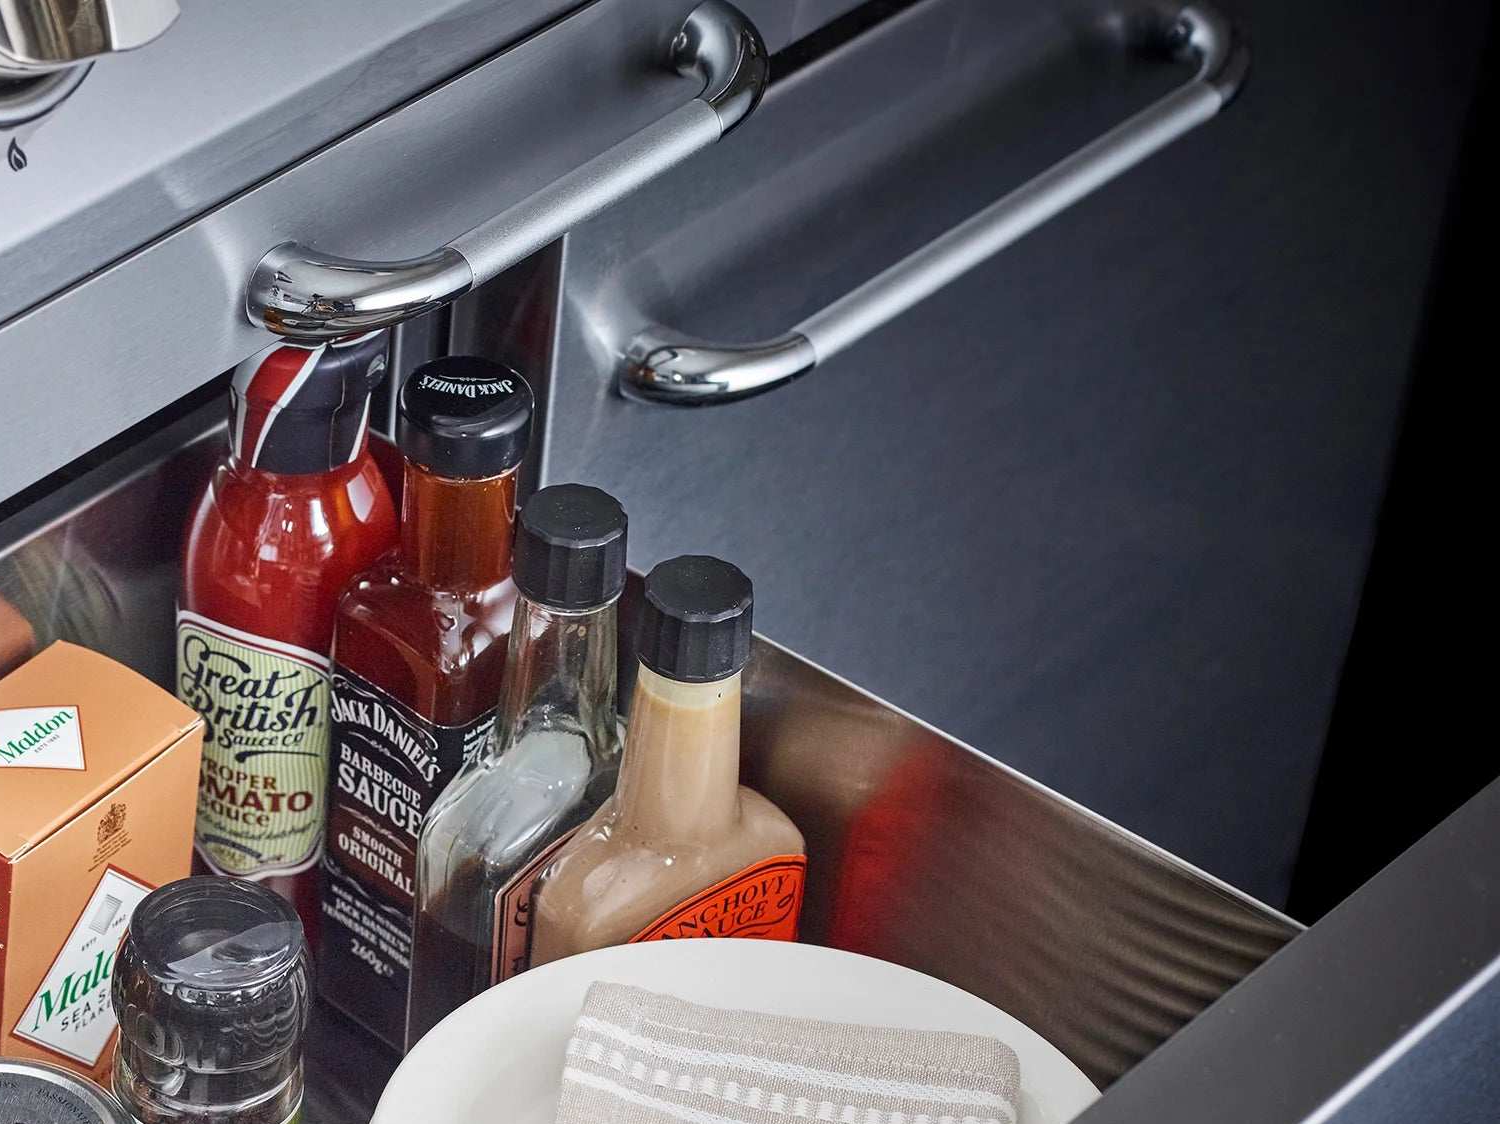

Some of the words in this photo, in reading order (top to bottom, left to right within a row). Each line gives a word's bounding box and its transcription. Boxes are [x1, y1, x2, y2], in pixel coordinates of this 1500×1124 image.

[477, 379, 514, 395] JACK
[184, 634, 301, 700] Great
[218, 728, 278, 749] Sauce
[331, 690, 372, 728] JACK
[373, 702, 441, 782] DANIEL'S
[338, 763, 422, 839] SAUCE
[340, 743, 421, 809] BARBECUE
[338, 833, 415, 897] ORIGINAL
[352, 826, 403, 867] SMOOTH
[688, 900, 769, 938] AUCE
[60, 1001, 93, 1032] SEA
